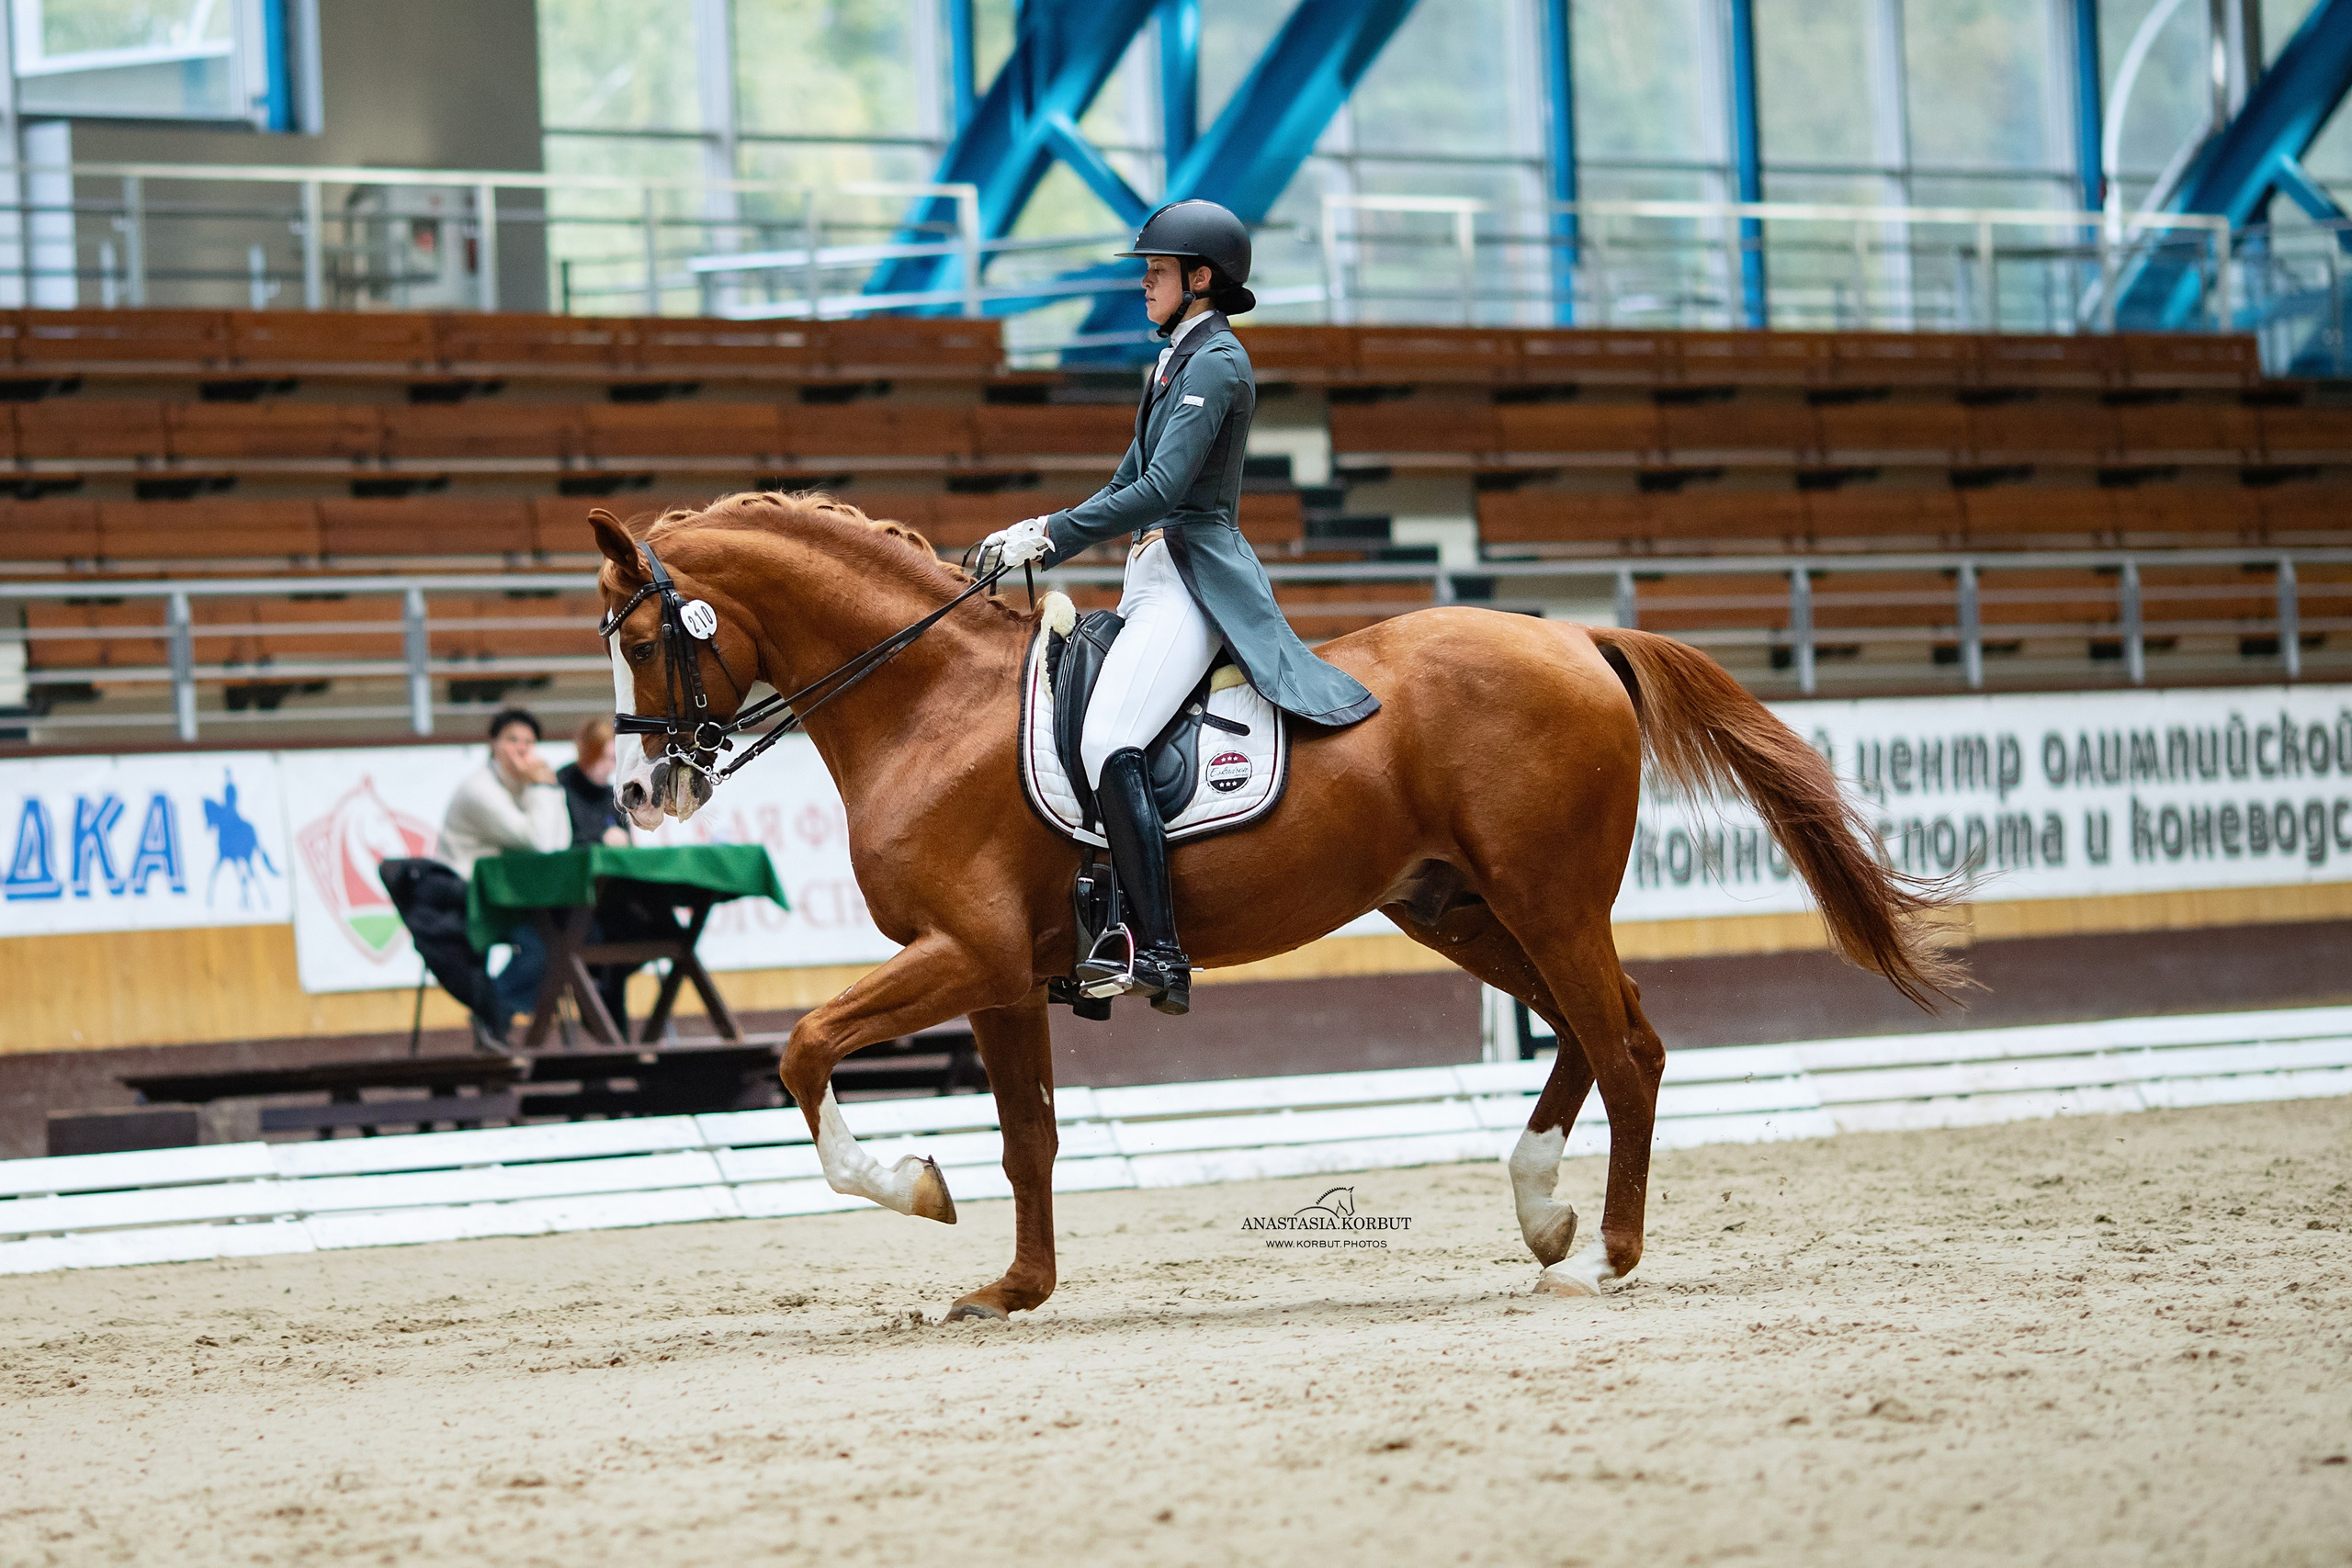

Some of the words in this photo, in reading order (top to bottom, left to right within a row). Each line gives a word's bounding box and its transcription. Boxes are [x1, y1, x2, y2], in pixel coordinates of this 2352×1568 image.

[687, 605, 714, 634] 210
[1858, 733, 2022, 805] центр
[2041, 710, 2352, 788] олимпийской
[0, 795, 187, 901] ДКА
[1634, 819, 1793, 887] конно
[2086, 809, 2109, 866] и
[2130, 793, 2352, 866] коневодс
